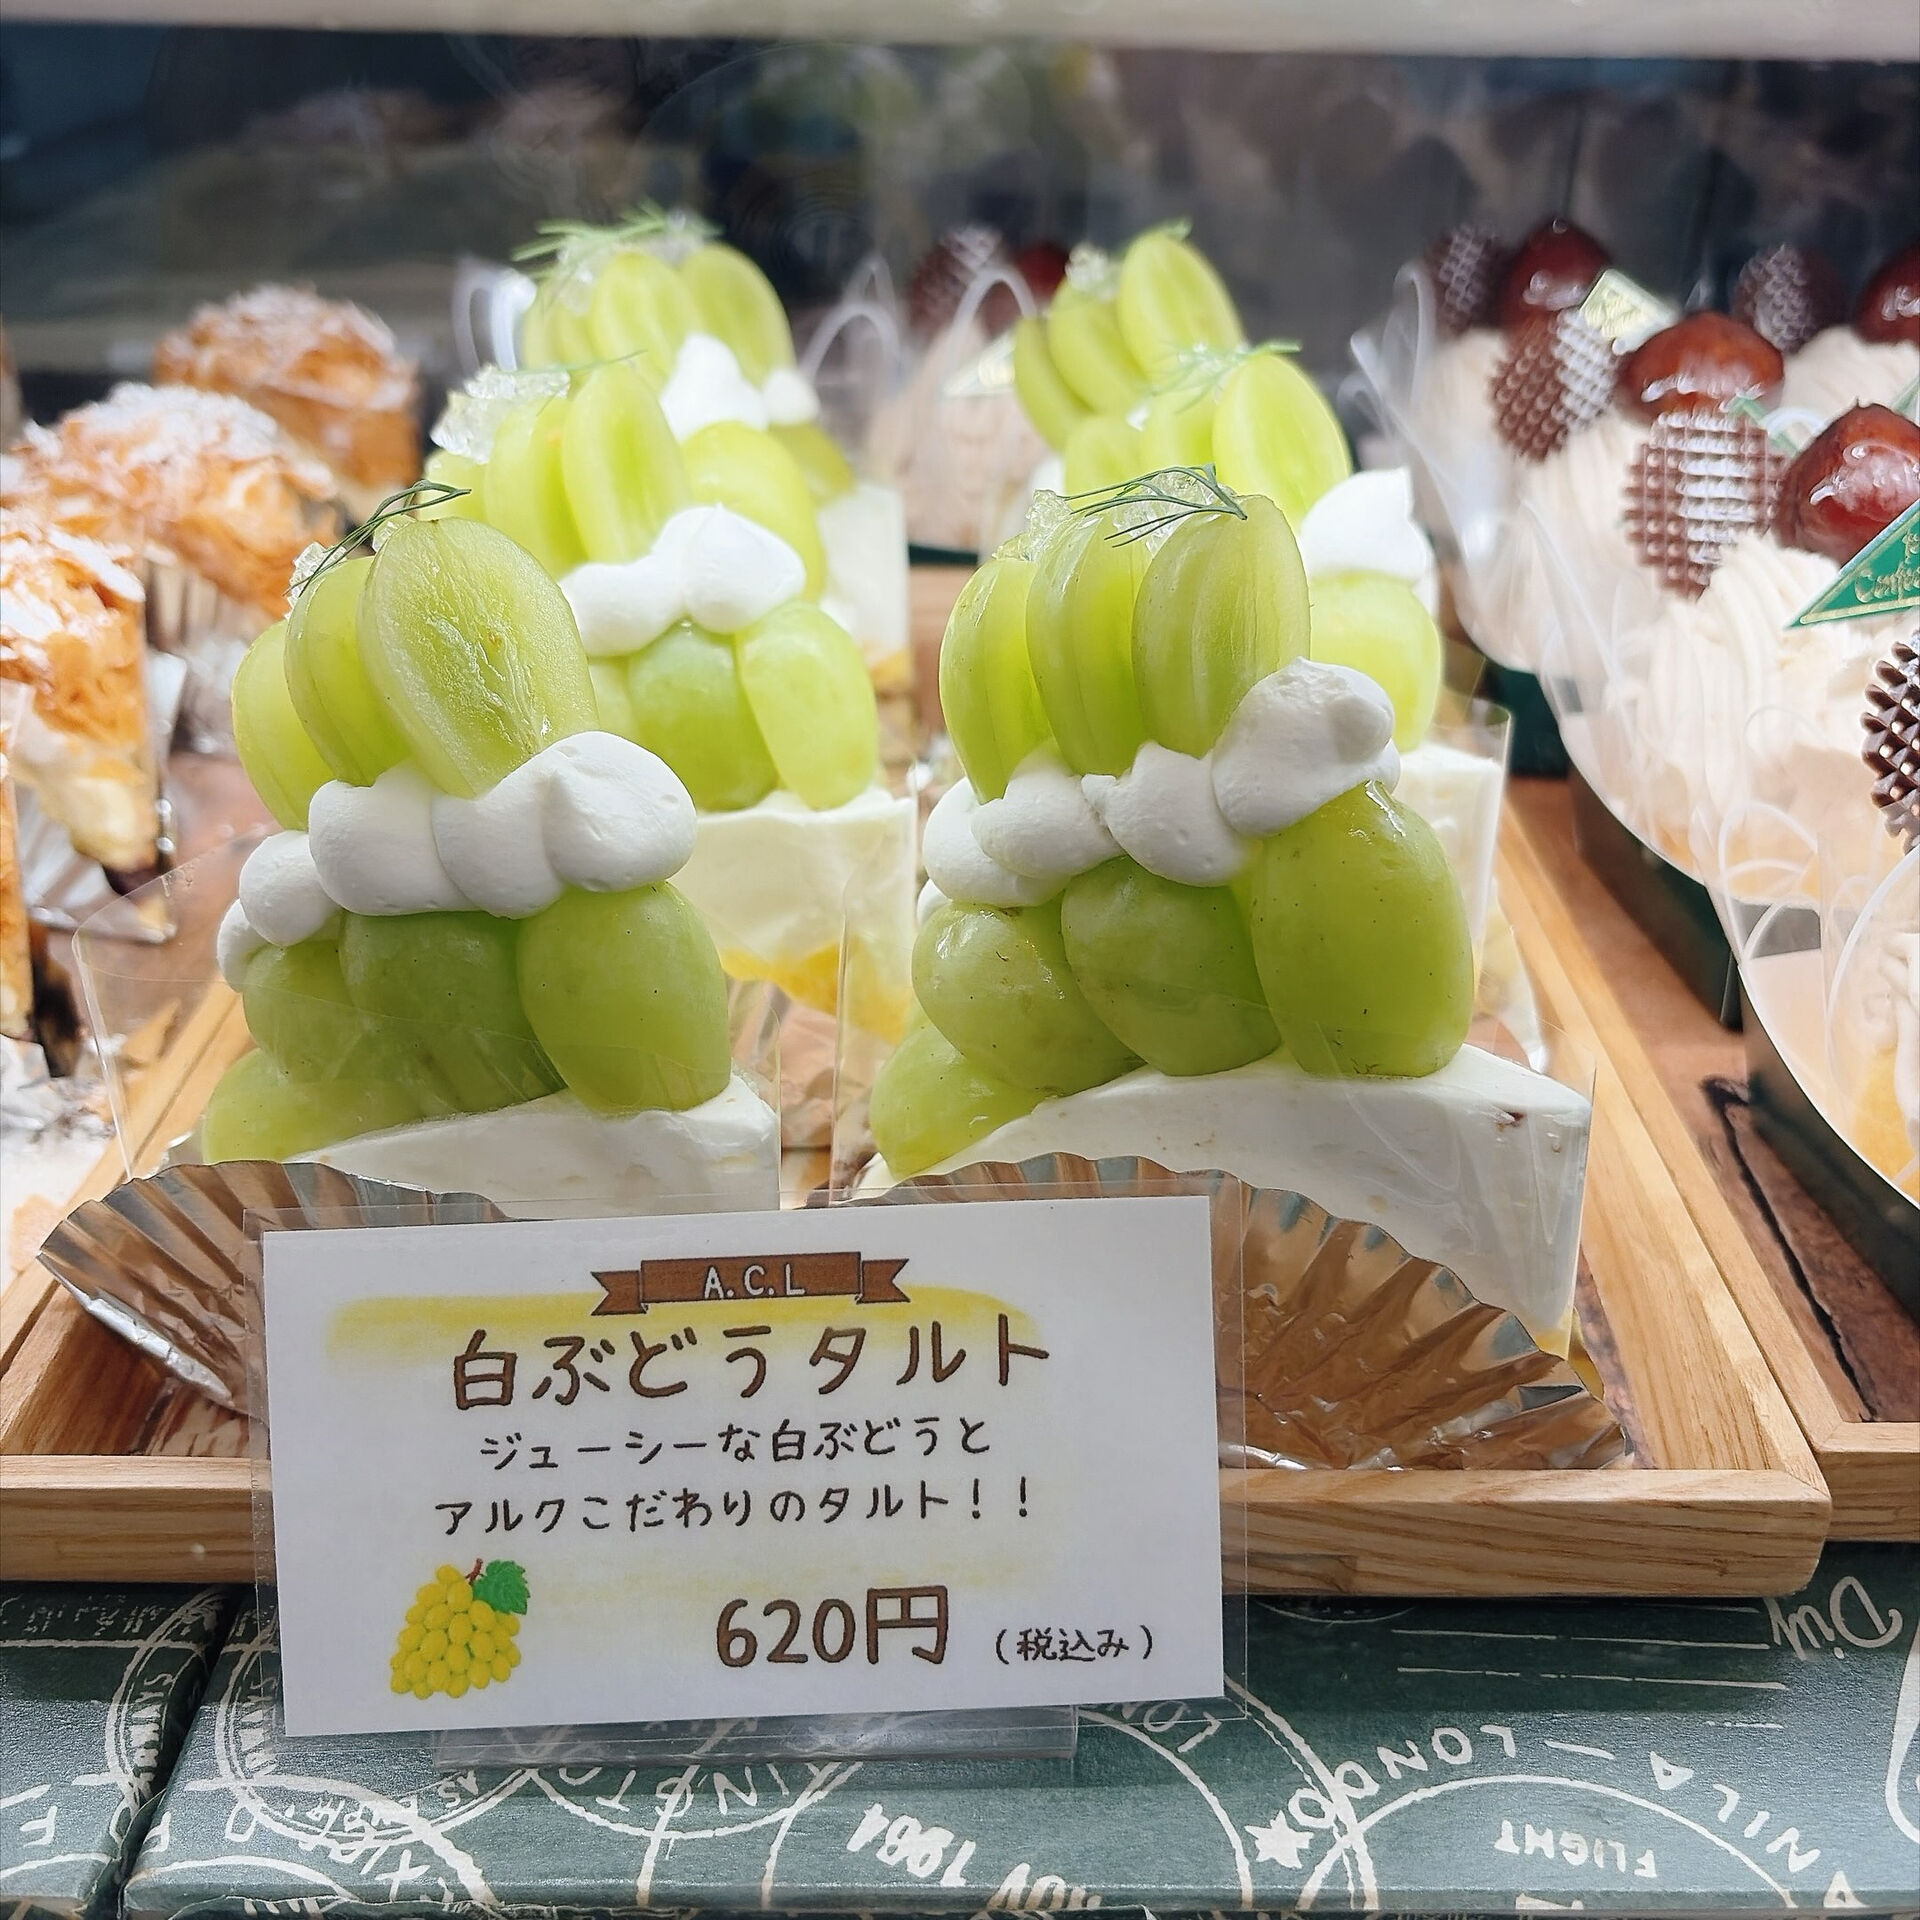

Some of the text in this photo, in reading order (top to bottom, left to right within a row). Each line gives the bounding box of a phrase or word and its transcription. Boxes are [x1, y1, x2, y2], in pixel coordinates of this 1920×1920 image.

[703, 1264, 804, 1299] A.C.L
[453, 1314, 1050, 1412] 白ぶどうタルト
[479, 1416, 992, 1470] ジューシーな白ぶどうと
[716, 1586, 949, 1669] 620円
[1494, 1820, 1657, 1878] FLIGHT
